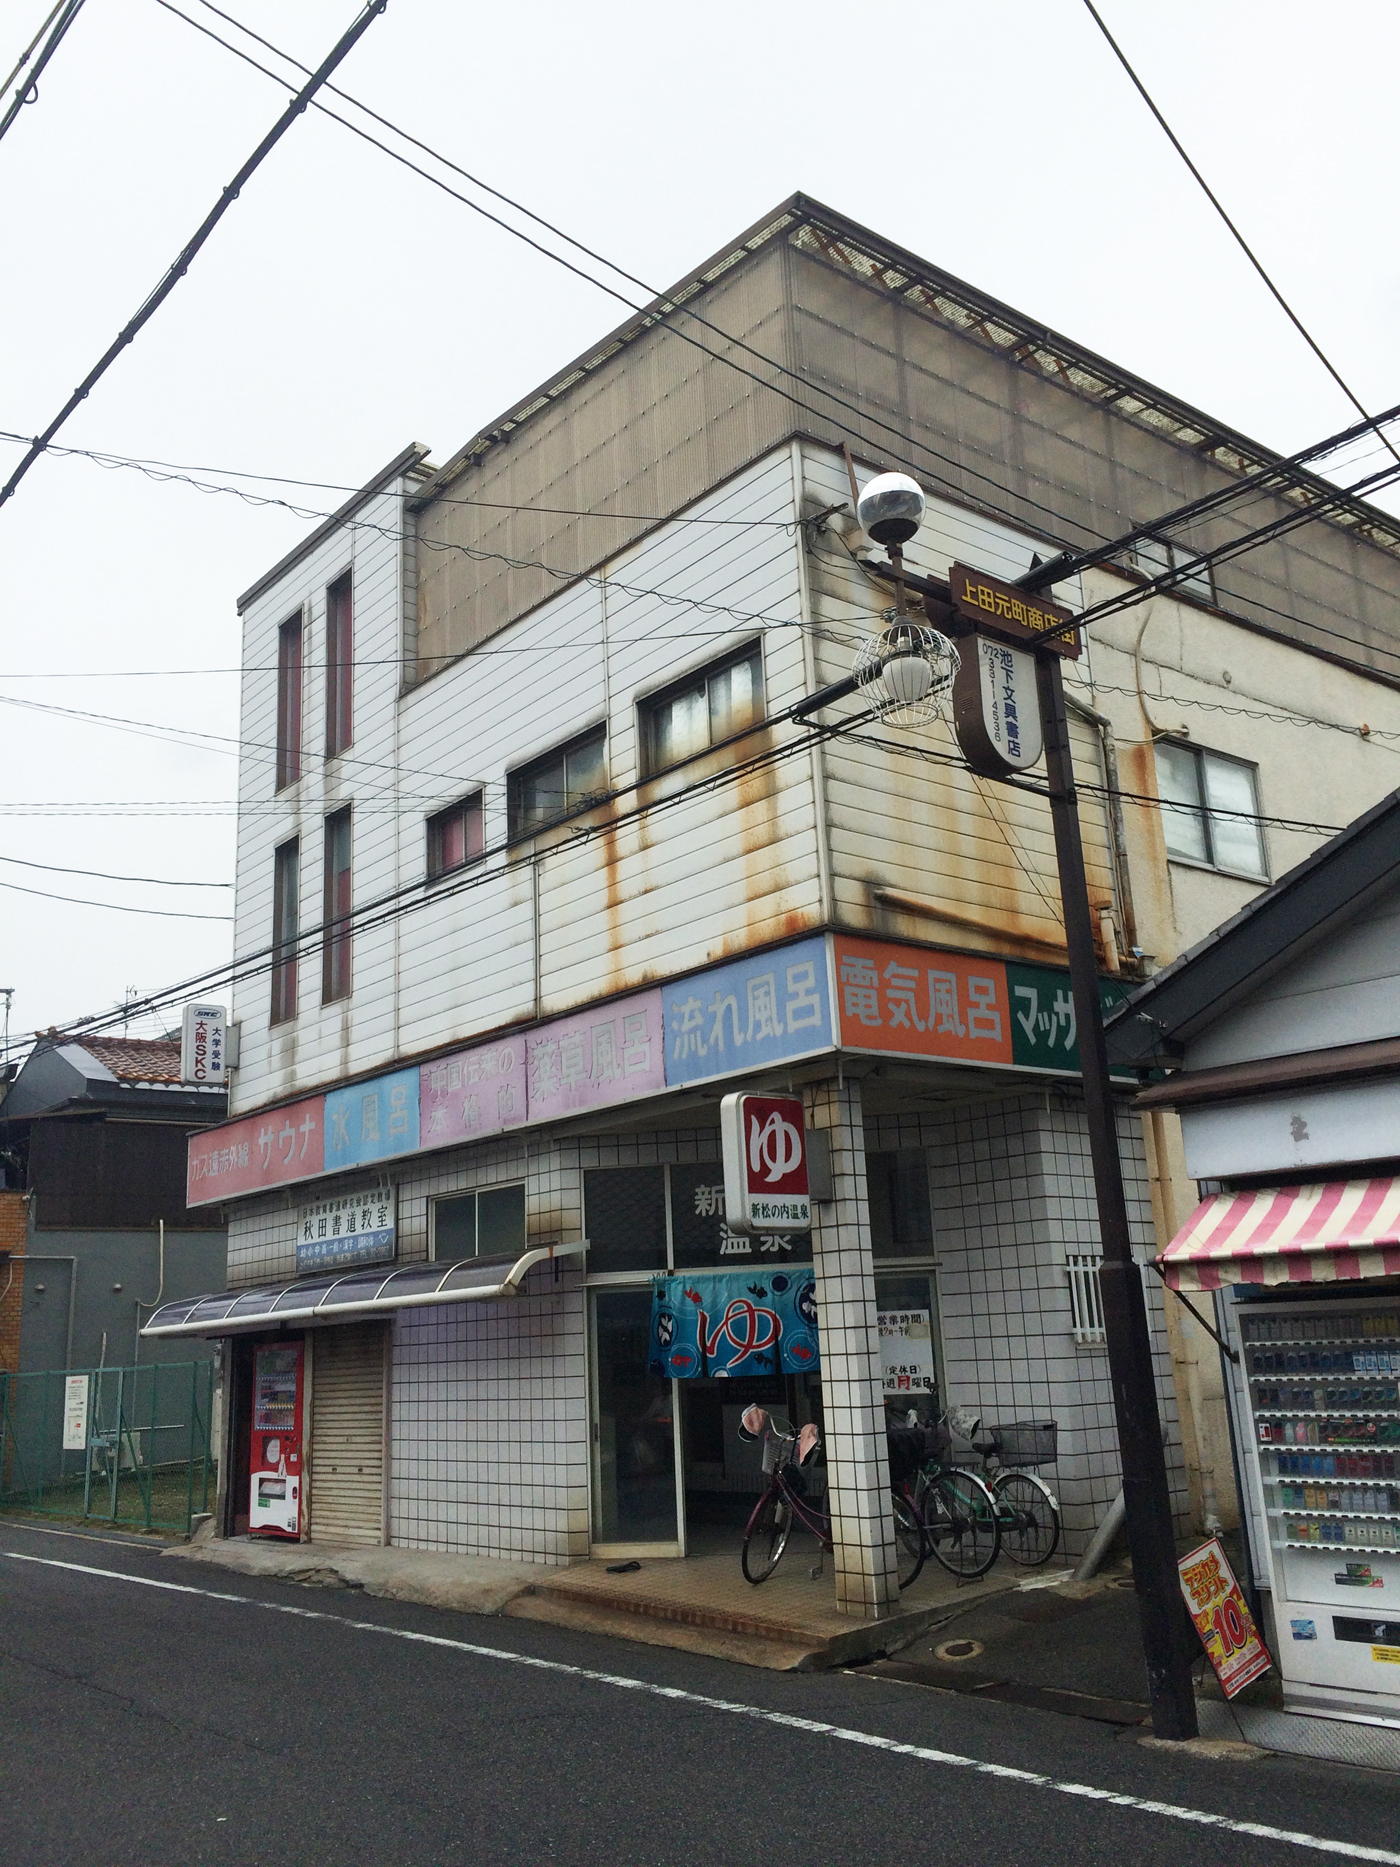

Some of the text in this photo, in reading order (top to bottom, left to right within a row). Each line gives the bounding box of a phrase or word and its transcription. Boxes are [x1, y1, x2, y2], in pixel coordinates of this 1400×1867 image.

[671, 960, 823, 1061] 流れ風呂
[841, 955, 1002, 1042] 電気風呂
[194, 1020, 208, 1080] 大阪SKC
[211, 1027, 222, 1072] 大学受験
[429, 1046, 515, 1098] 中国伝来の
[531, 1010, 651, 1101] 薬草風呂
[331, 1083, 409, 1151] 水風呂
[428, 1084, 516, 1133] 本格的
[258, 1113, 316, 1170] サウナ
[750, 1111, 802, 1183] ゆ
[303, 1205, 388, 1241] 秋田書道教室
[751, 1203, 809, 1220] 新松の内温泉
[697, 1297, 784, 1368] ゆ
[1180, 1550, 1221, 1590] デジカメ
[1212, 1596, 1248, 1658] 10
